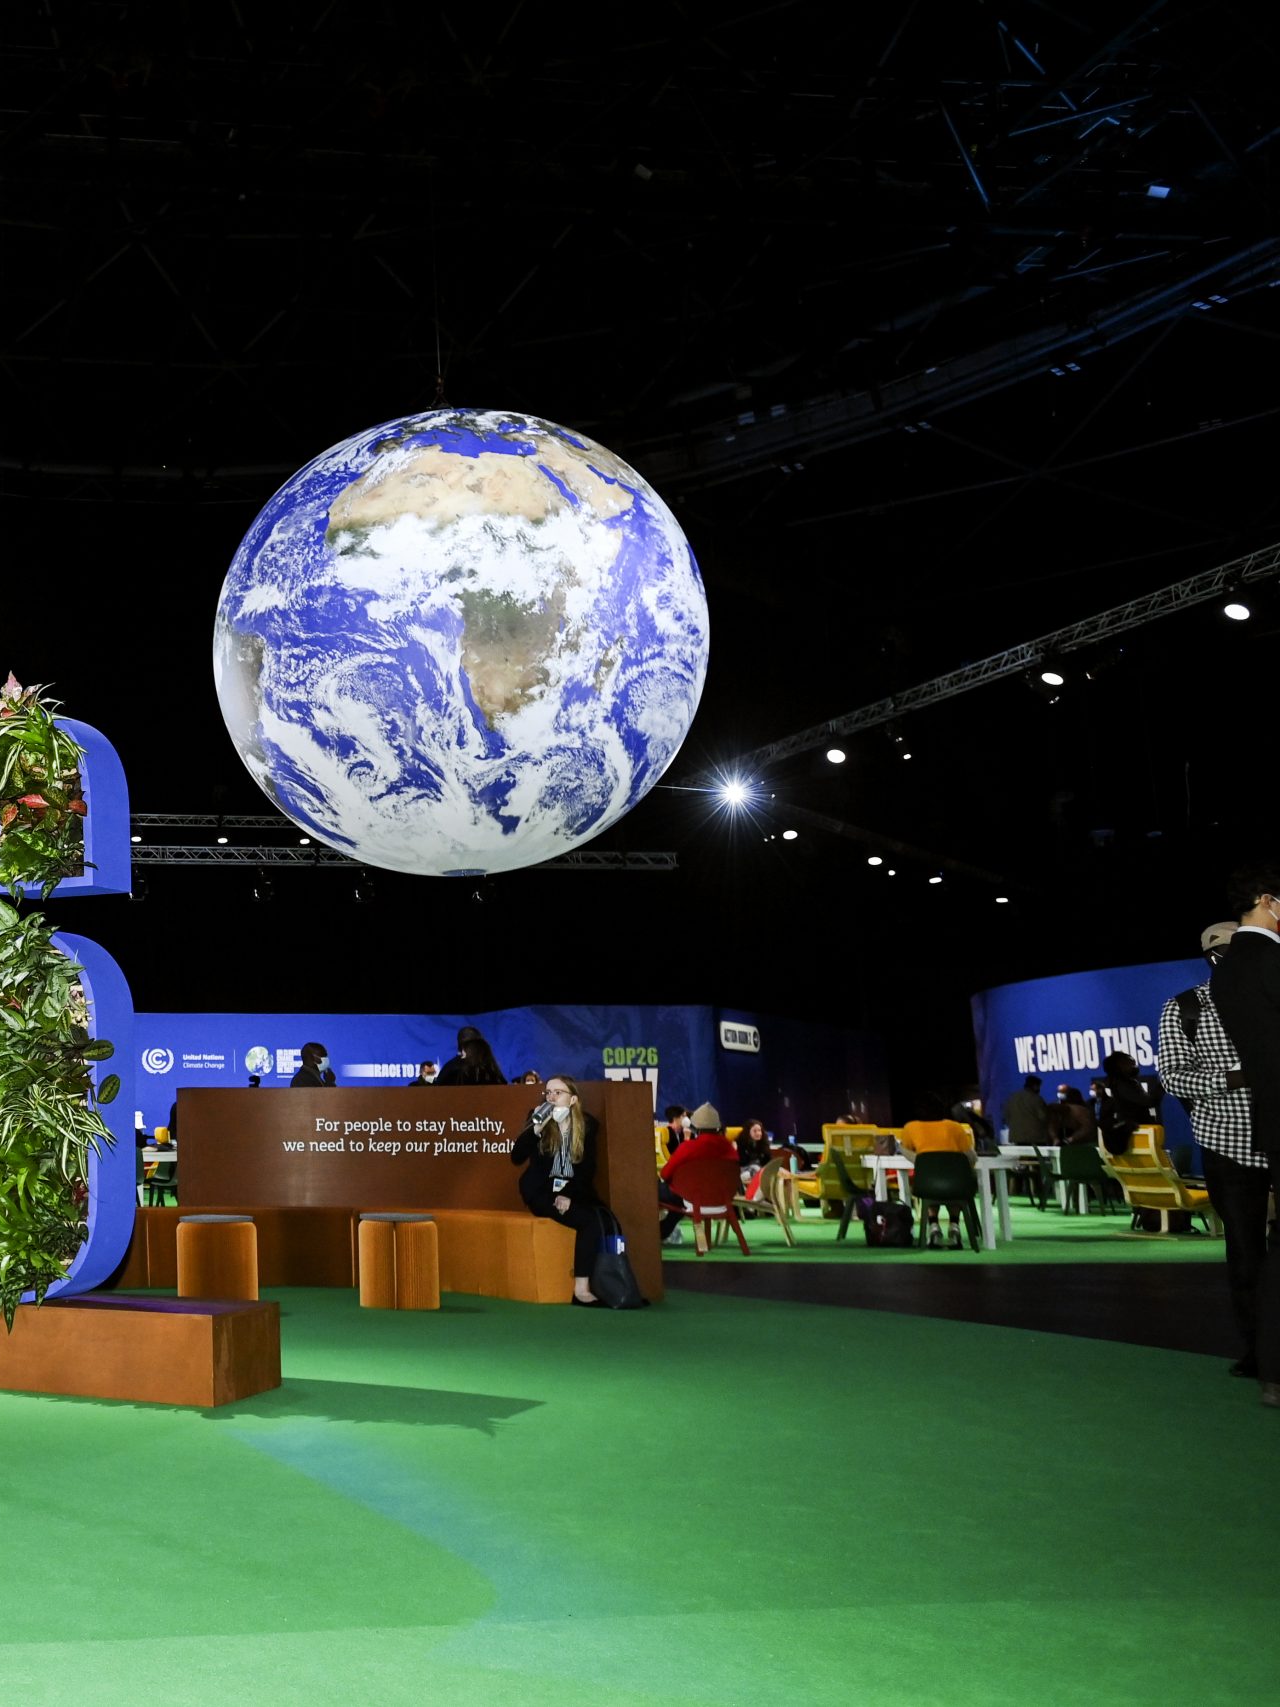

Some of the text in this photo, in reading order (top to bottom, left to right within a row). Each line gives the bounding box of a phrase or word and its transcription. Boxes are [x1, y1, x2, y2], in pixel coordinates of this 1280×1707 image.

[182, 1053, 225, 1061] United Nations
[602, 1047, 659, 1066] COP26
[1014, 1037, 1036, 1073] WE
[1036, 1034, 1070, 1072] CAN
[1070, 1029, 1100, 1070] DO
[204, 1062, 225, 1070] Change
[315, 1117, 506, 1136] For people to stay healthy,
[283, 1140, 305, 1153] we
[309, 1138, 345, 1153] need
[349, 1139, 364, 1153] to
[368, 1138, 401, 1156] keep
[405, 1141, 431, 1153] our
[433, 1138, 479, 1156] planet
